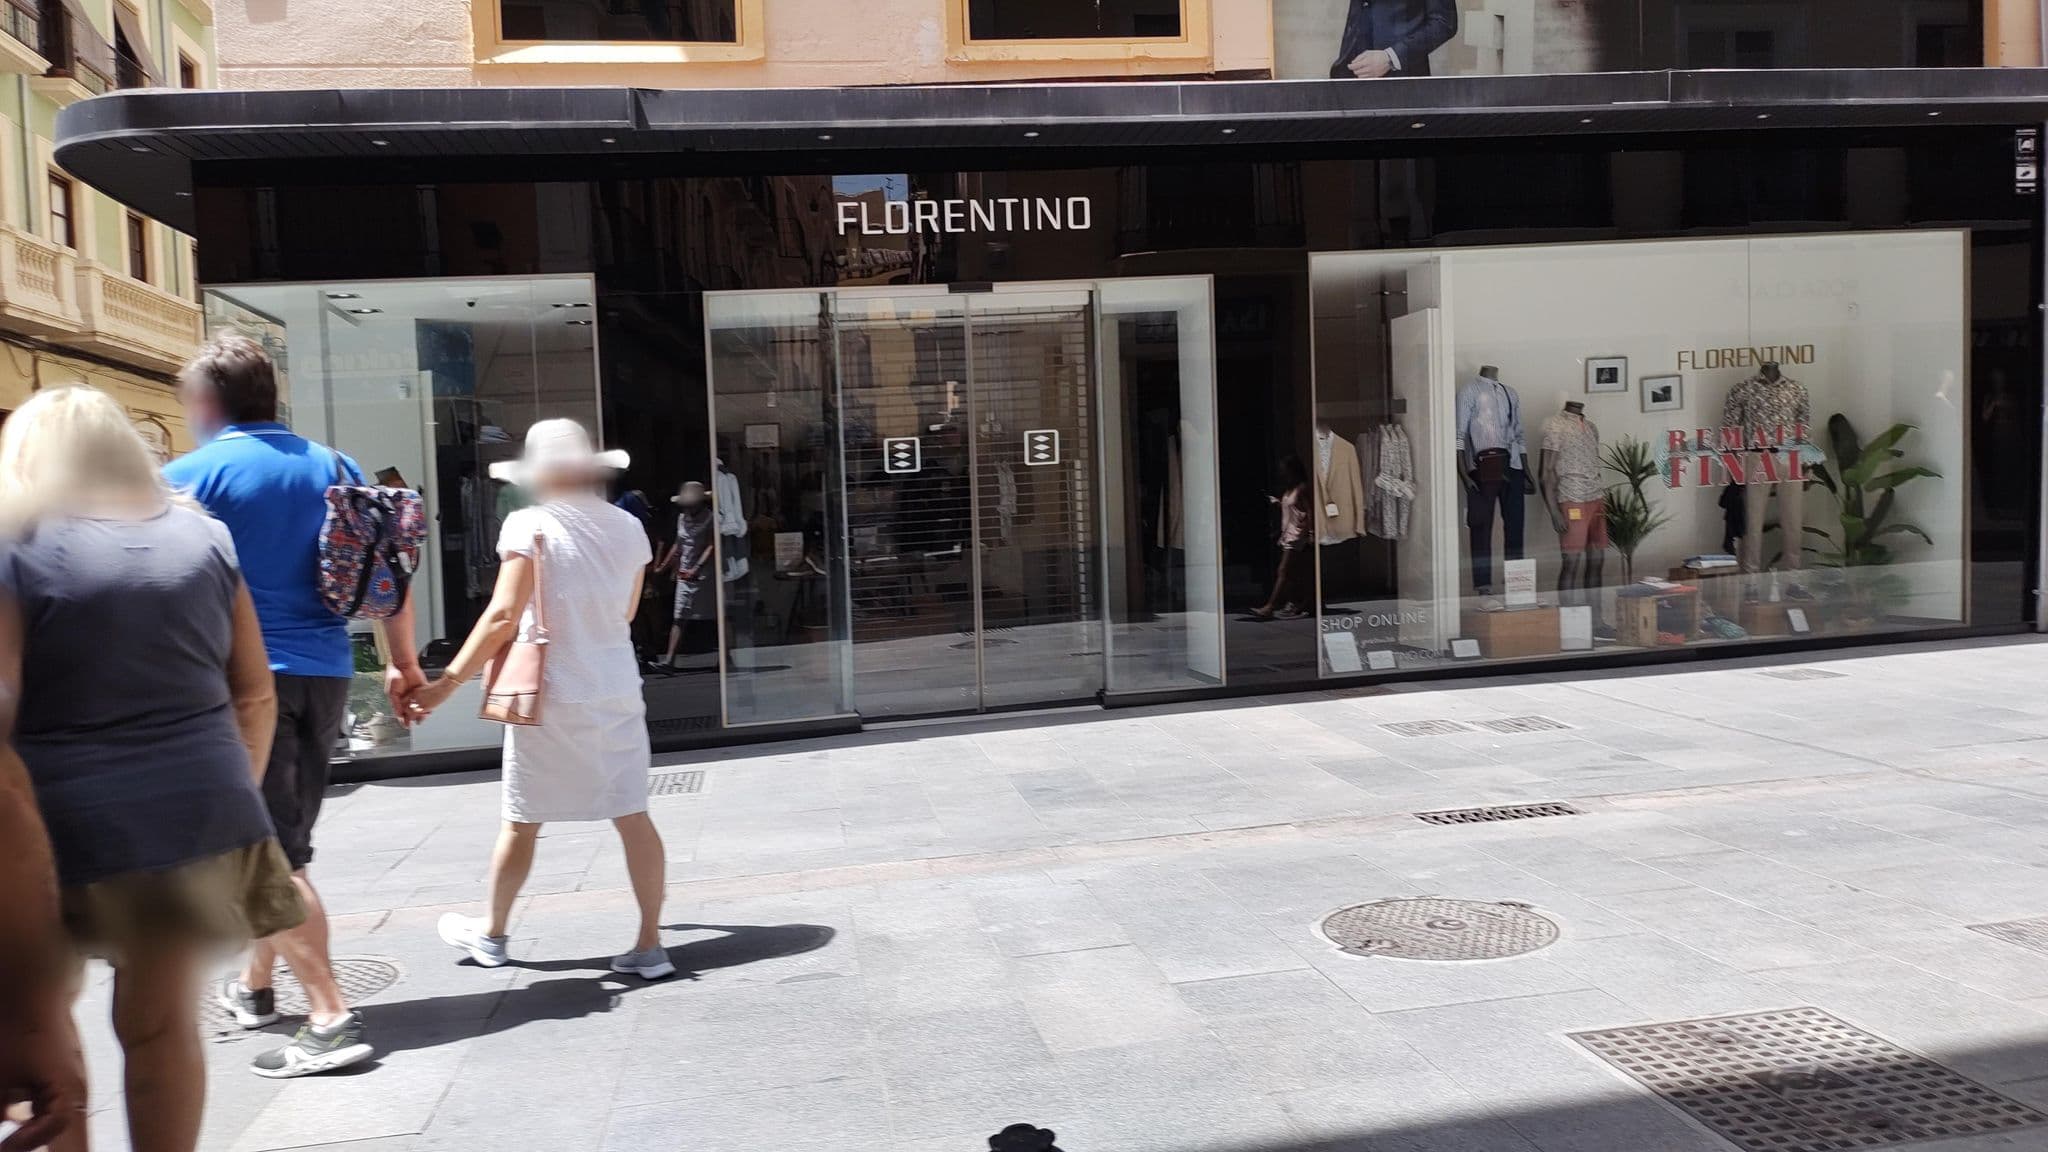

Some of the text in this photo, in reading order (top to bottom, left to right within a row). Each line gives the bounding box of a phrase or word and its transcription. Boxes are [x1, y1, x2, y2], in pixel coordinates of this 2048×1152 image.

[836, 196, 1092, 236] FLORENTINO
[1677, 344, 1815, 370] FLORENTINO
[1667, 423, 1807, 451] REMATE
[1669, 450, 1809, 488] FINAL
[1321, 608, 1428, 632] SHOP ONLINE
